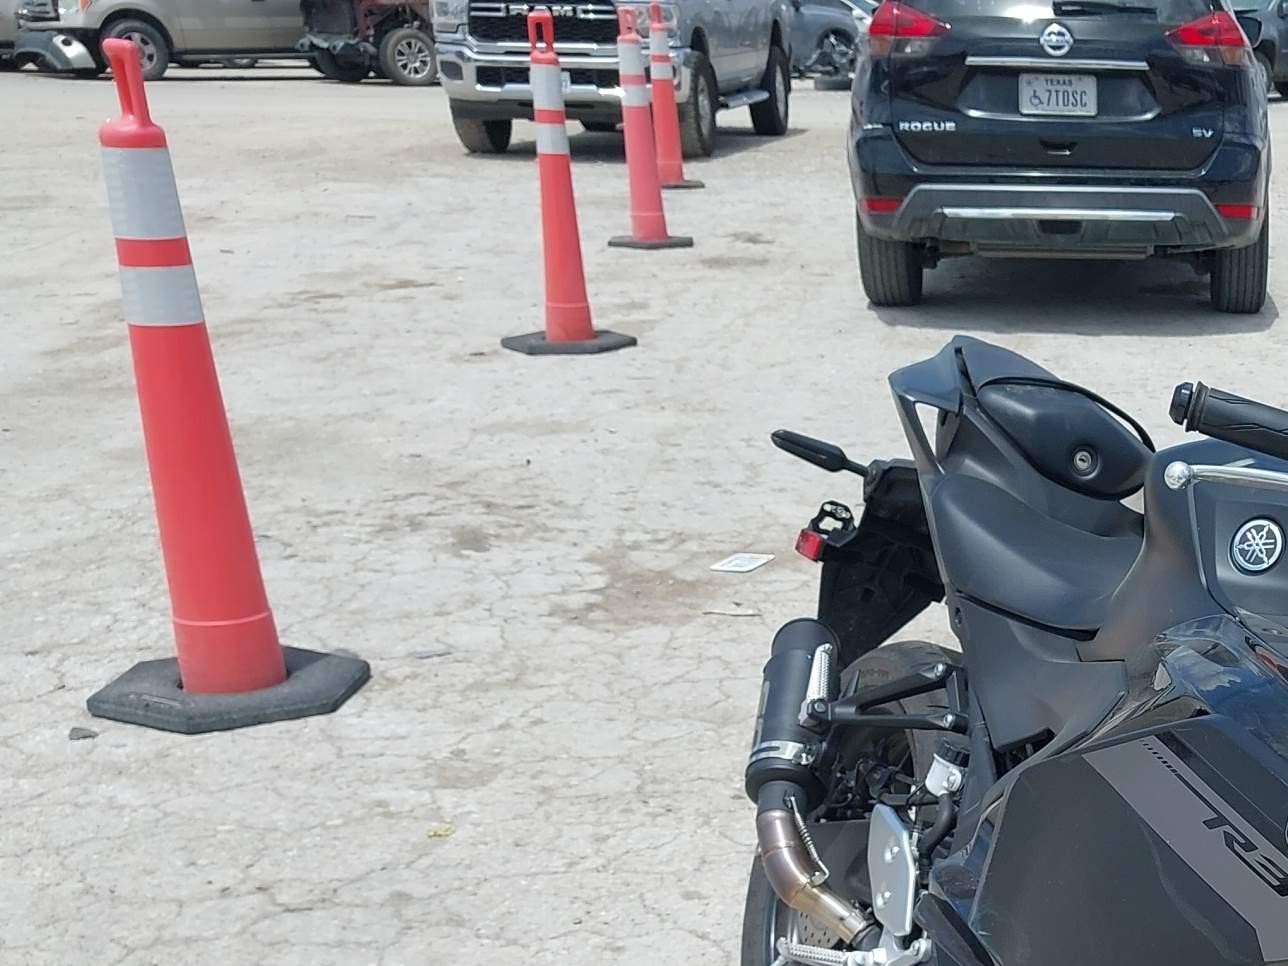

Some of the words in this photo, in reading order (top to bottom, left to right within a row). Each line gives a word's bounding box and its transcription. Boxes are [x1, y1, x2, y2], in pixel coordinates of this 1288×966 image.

[1044, 78, 1073, 87] TEXAS
[899, 121, 956, 131] ROGUE
[1192, 128, 1213, 138] SV
